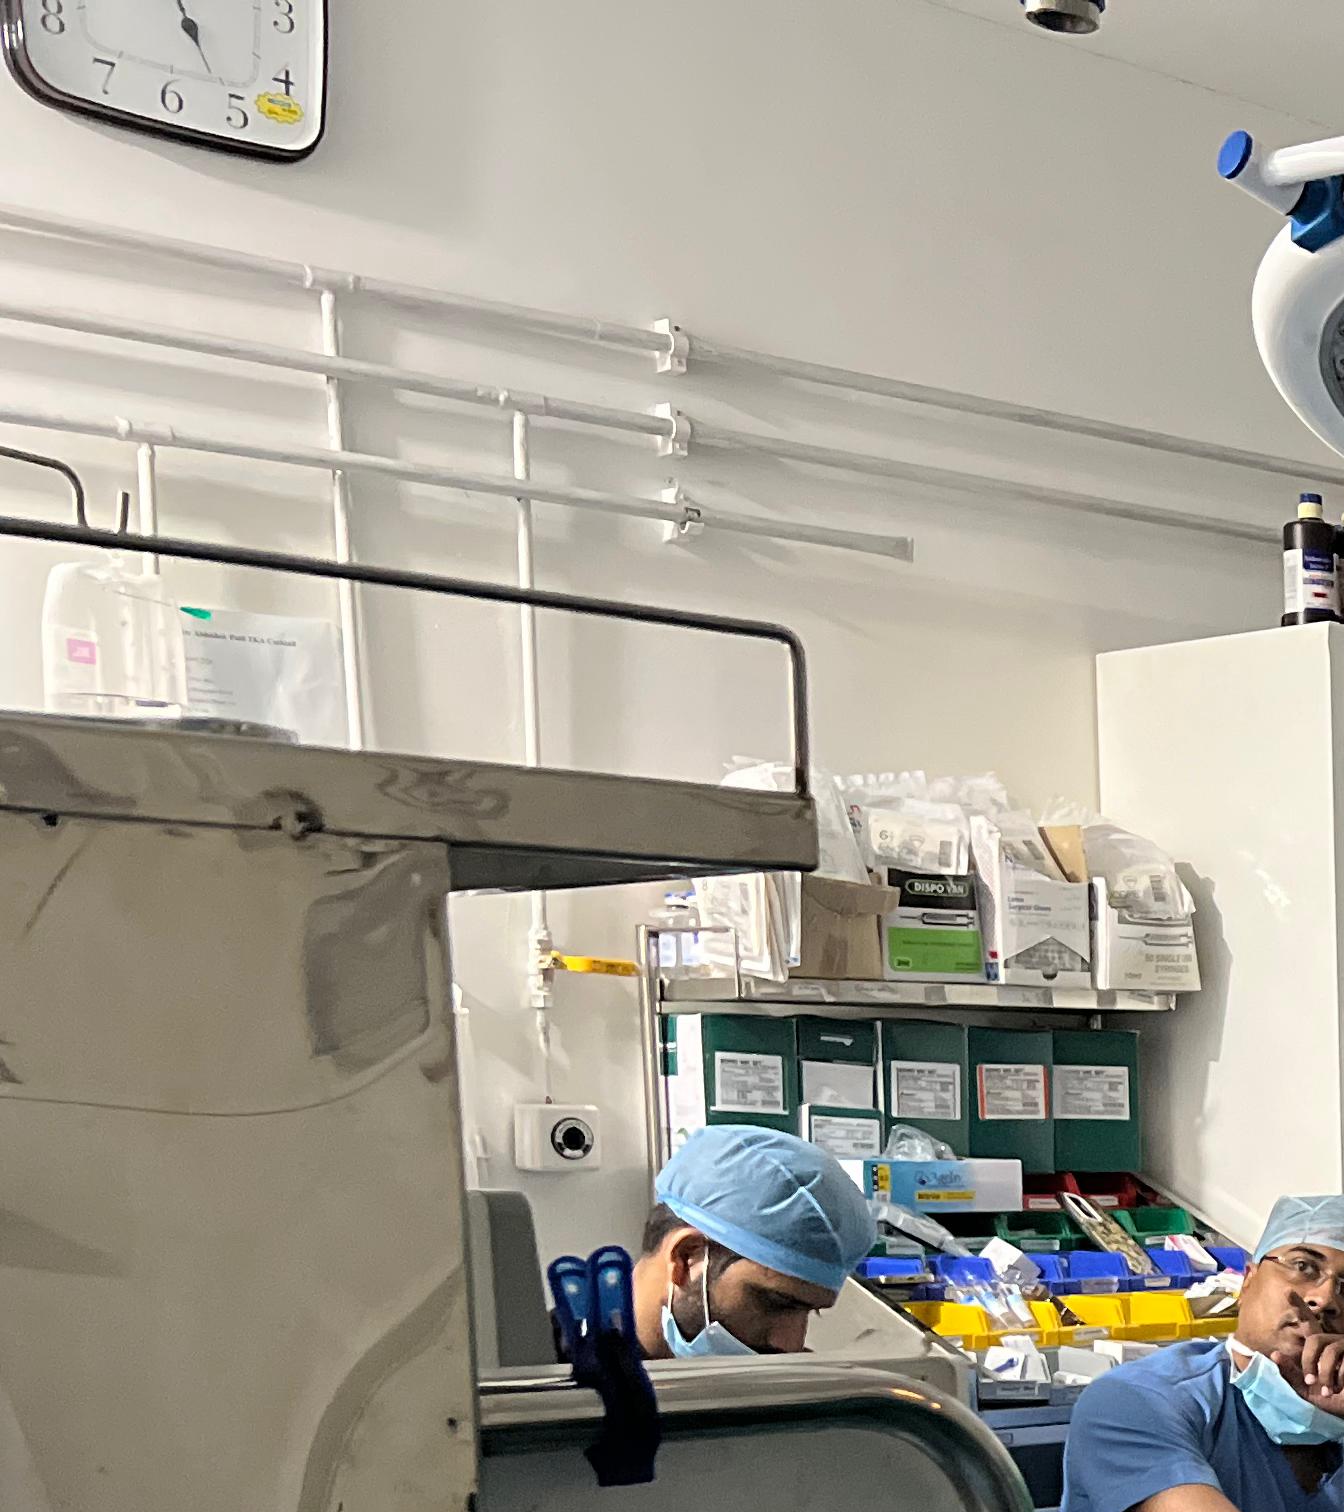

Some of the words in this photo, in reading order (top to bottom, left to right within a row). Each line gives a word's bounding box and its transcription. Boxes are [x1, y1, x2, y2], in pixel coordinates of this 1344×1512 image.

[41, 0, 65, 35] 8
[273, 0, 296, 34] 3
[92, 57, 117, 95] 7
[272, 65, 296, 97] 4
[160, 79, 184, 115] 6
[226, 92, 250, 129] 5
[913, 881, 945, 895] DISPO
[946, 884, 964, 894] VAN
